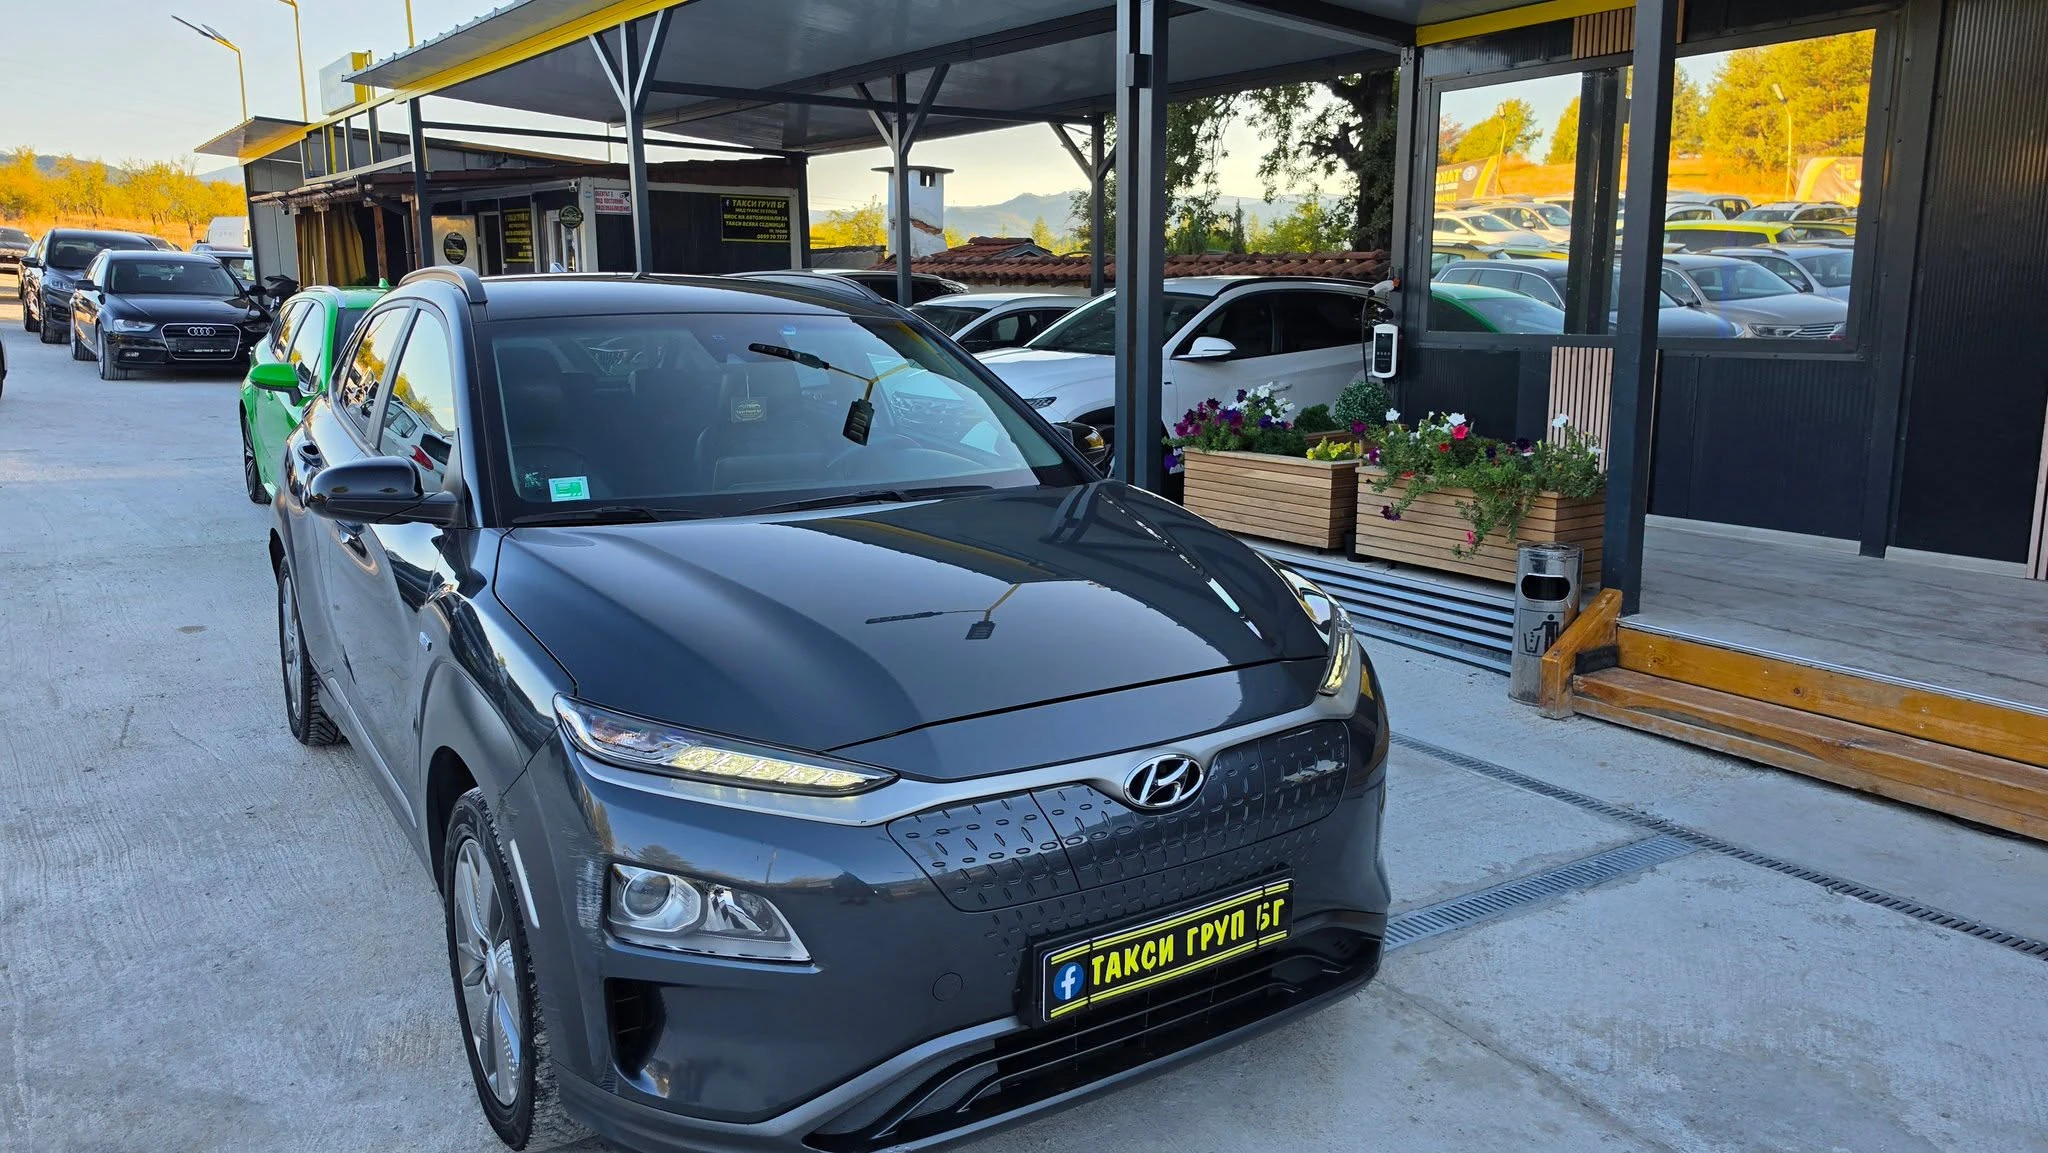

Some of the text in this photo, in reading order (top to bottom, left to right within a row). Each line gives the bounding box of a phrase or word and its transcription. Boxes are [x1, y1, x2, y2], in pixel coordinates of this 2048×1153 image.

[732, 199, 757, 207] ТАКСИ
[757, 200, 776, 208] ГРУП
[777, 201, 786, 209] БГ
[1091, 934, 1174, 986] ТАКСИ
[1187, 909, 1245, 956] ГРУП
[1256, 898, 1285, 931] БГ
